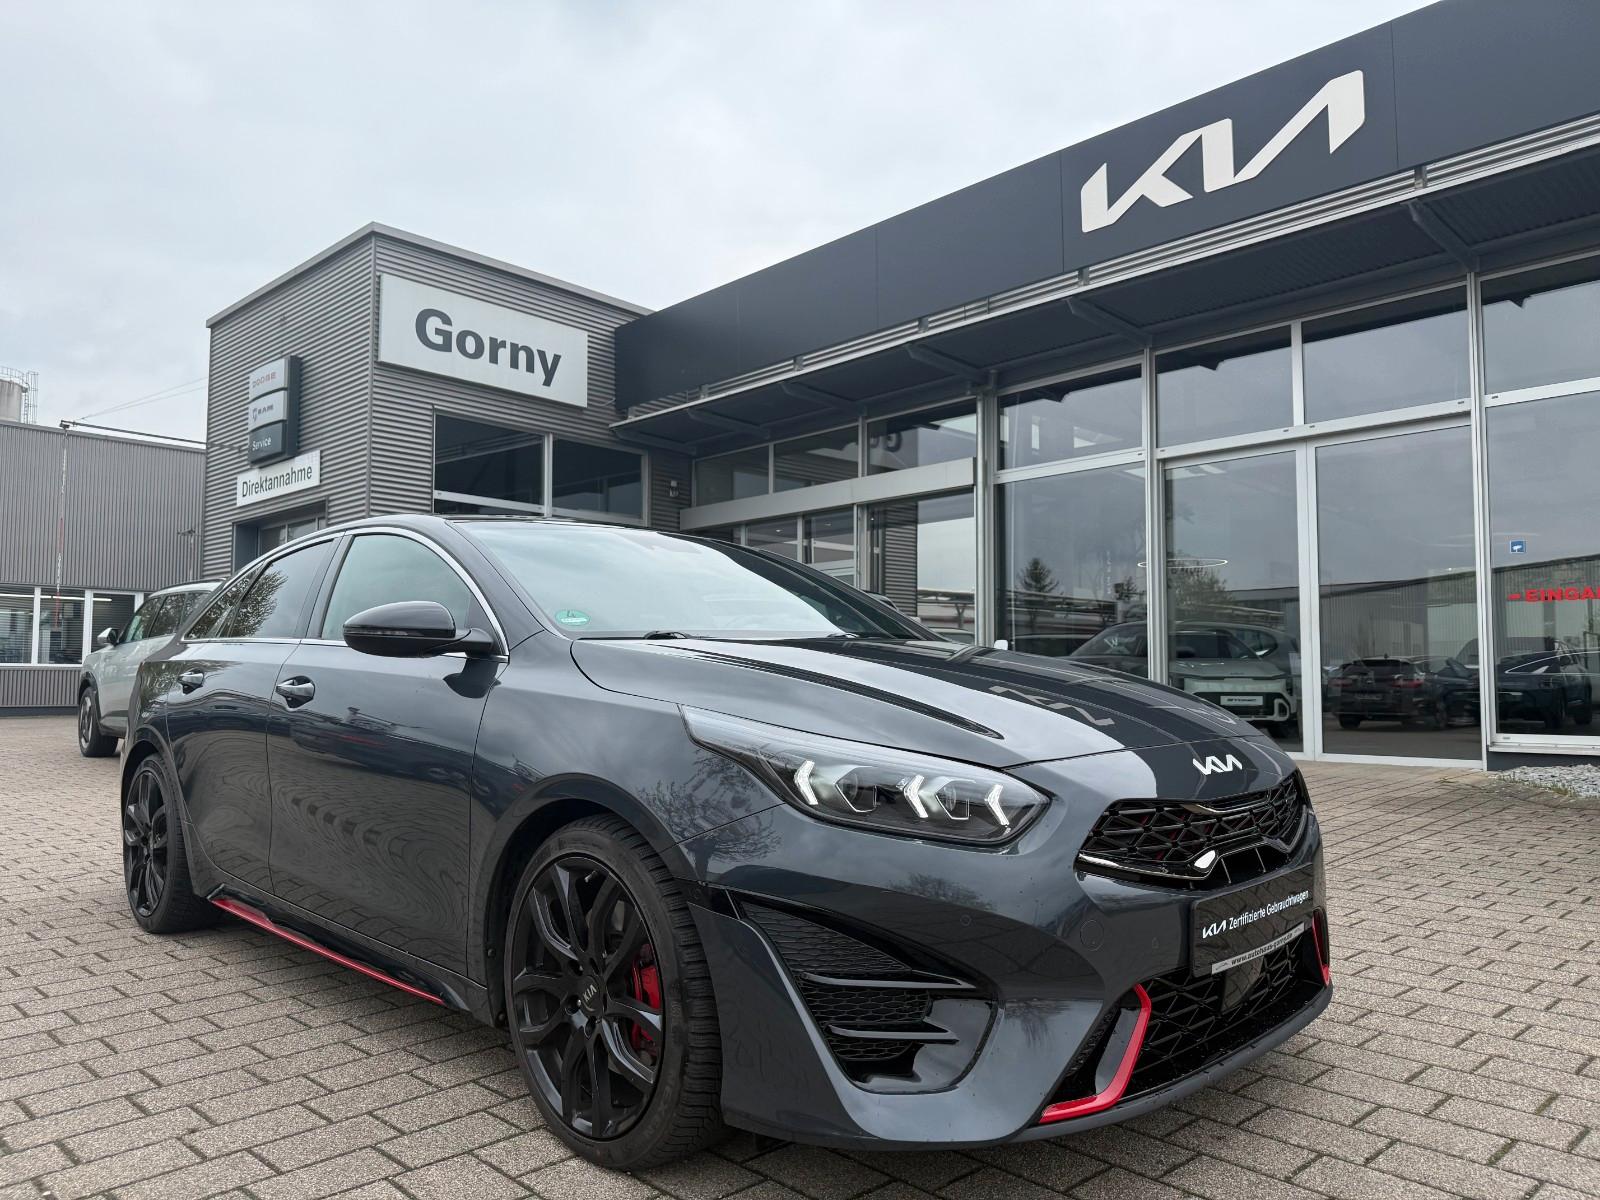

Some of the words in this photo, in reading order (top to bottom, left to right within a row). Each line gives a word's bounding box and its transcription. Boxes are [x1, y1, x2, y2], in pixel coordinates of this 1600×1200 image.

[1080, 69, 1366, 233] KIA
[415, 308, 562, 387] Gorny
[252, 437, 271, 451] Service
[242, 466, 312, 497] Direktannahme
[1192, 754, 1243, 776] KIA
[1229, 908, 1265, 929] Zertifizierte
[1266, 890, 1308, 915] Gebrauchtwagen
[582, 984, 598, 1003] KIA
